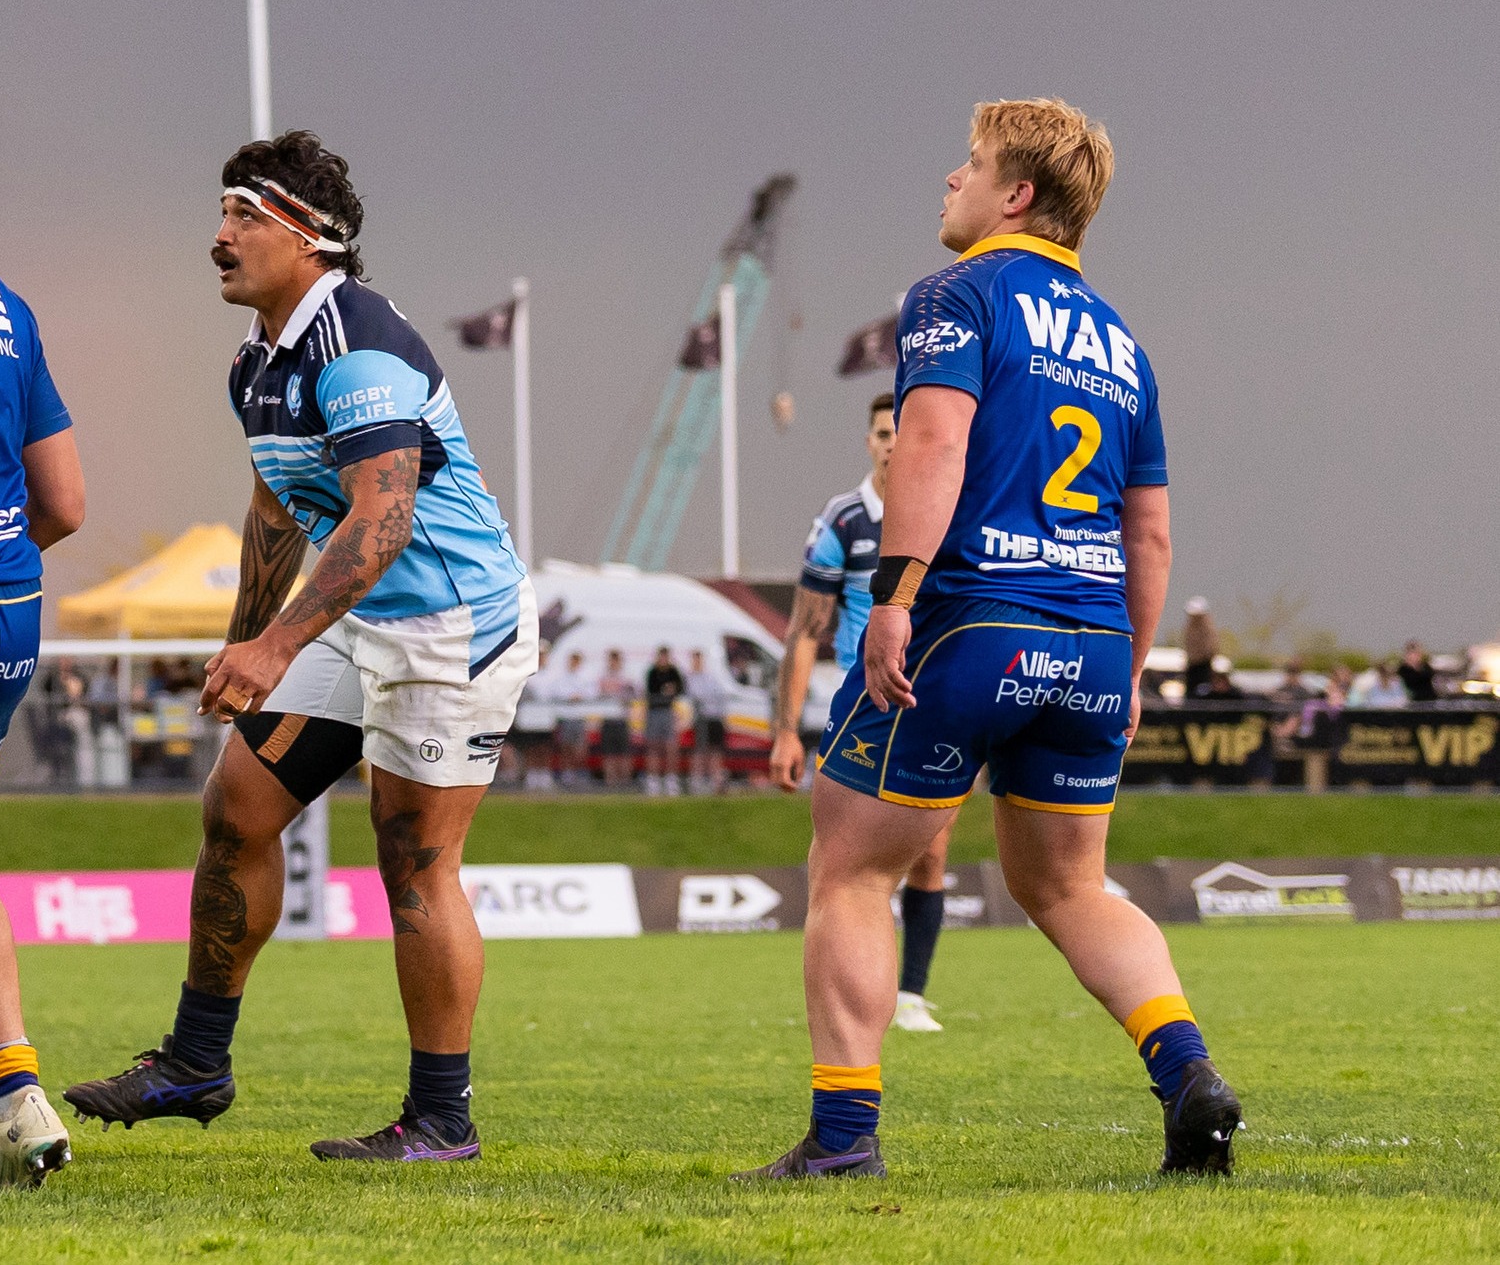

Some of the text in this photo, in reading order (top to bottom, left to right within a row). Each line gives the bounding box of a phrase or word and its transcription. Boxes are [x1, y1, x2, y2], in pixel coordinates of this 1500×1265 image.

[900, 321, 974, 363] Prezzy
[925, 342, 956, 353] Card
[1014, 292, 1140, 392] WAE
[327, 384, 393, 413] RUGBY
[1029, 354, 1139, 417] ENGINEERING
[355, 401, 397, 422] LIFE
[1041, 405, 1103, 514] 2
[981, 526, 1126, 573] THE BREEZE
[1005, 649, 1084, 682] Allied
[995, 677, 1122, 715] Petroleum
[841, 749, 877, 769] GILBERT
[1183, 722, 1263, 766] VIP
[1416, 722, 1494, 766] VIP
[1066, 773, 1119, 788] SOUTHBASE
[472, 880, 590, 916] ARC
